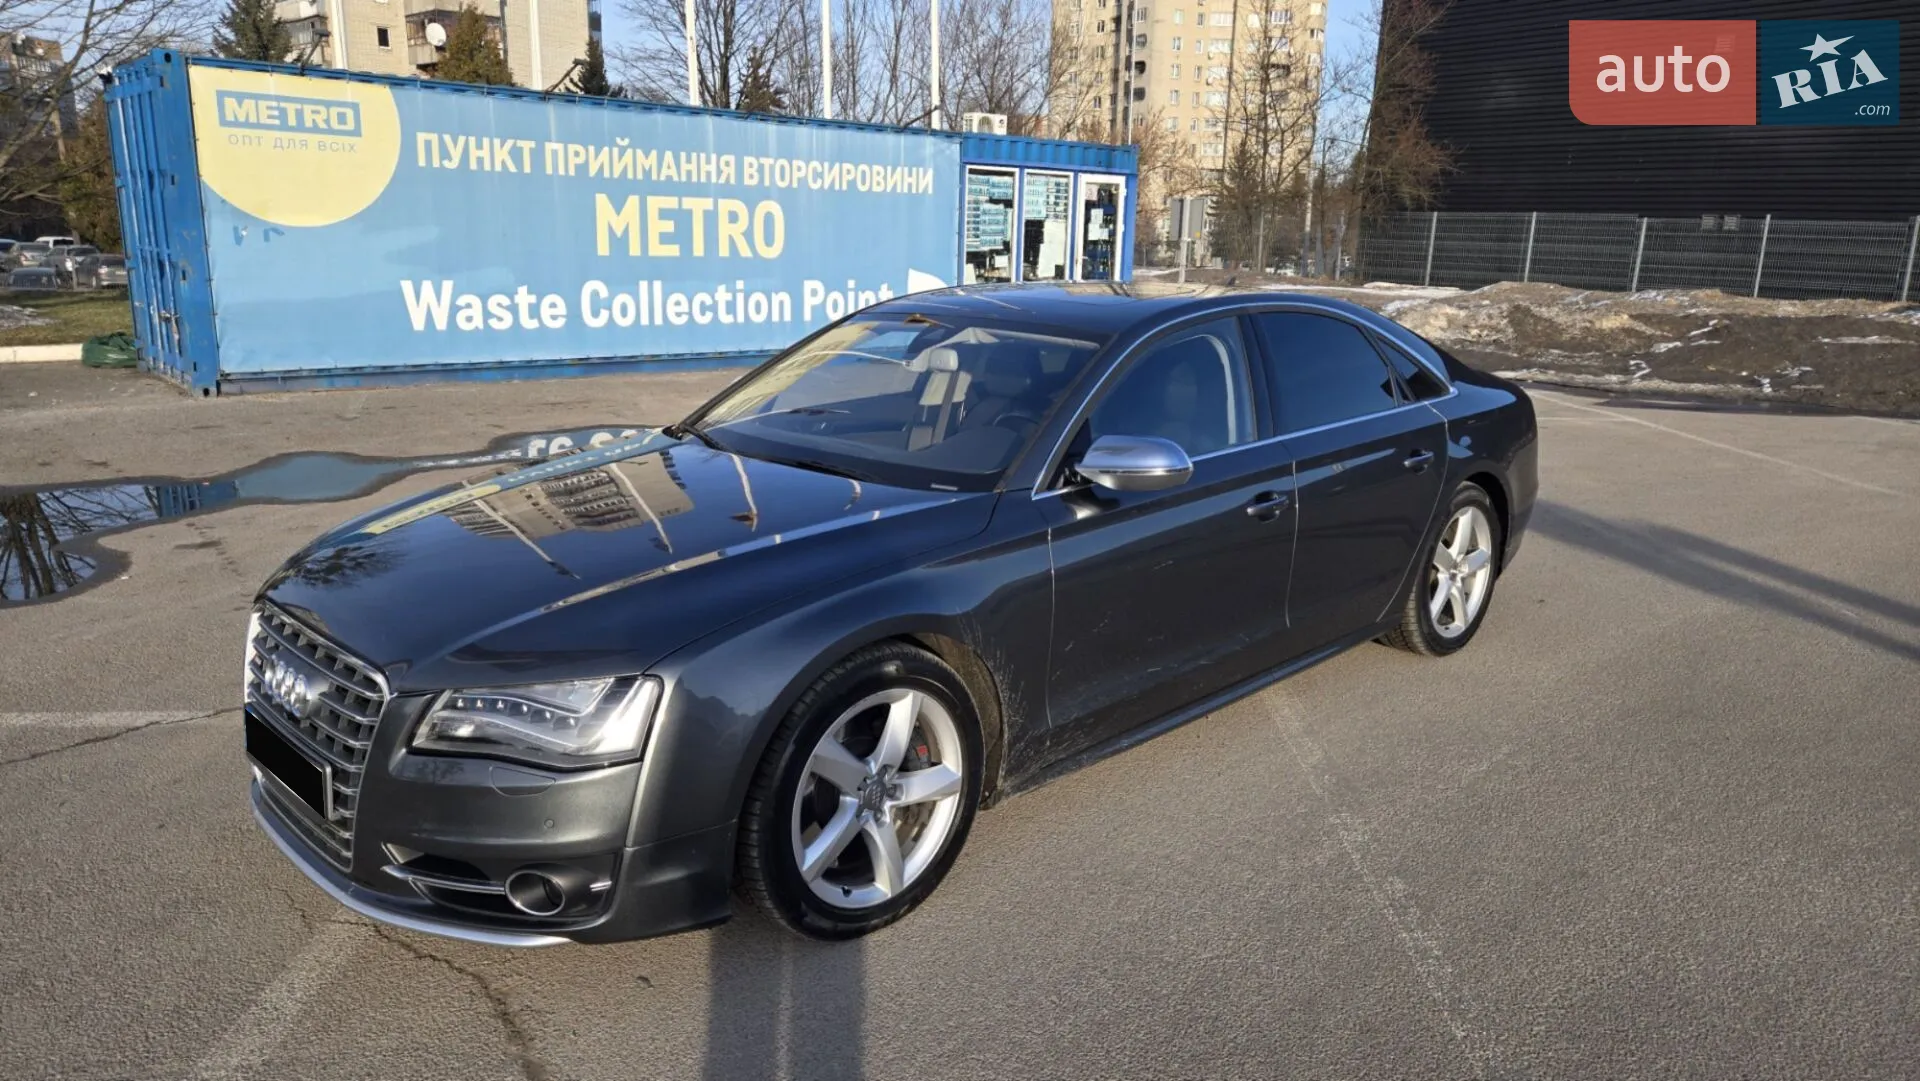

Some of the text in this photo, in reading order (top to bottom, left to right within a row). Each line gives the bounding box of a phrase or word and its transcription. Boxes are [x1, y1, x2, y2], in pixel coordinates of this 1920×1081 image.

[223, 97, 356, 131] METRO
[228, 133, 358, 153] ОПТ ДЛЯ ВСІХ
[416, 131, 536, 174] ПУНКТ
[544, 137, 736, 186] ПРИЙМАННЯ
[743, 156, 934, 195] ВТОРСИРОВИНИ
[595, 193, 786, 260] METRO
[400, 280, 567, 331] Waste
[581, 279, 792, 328] Collection
